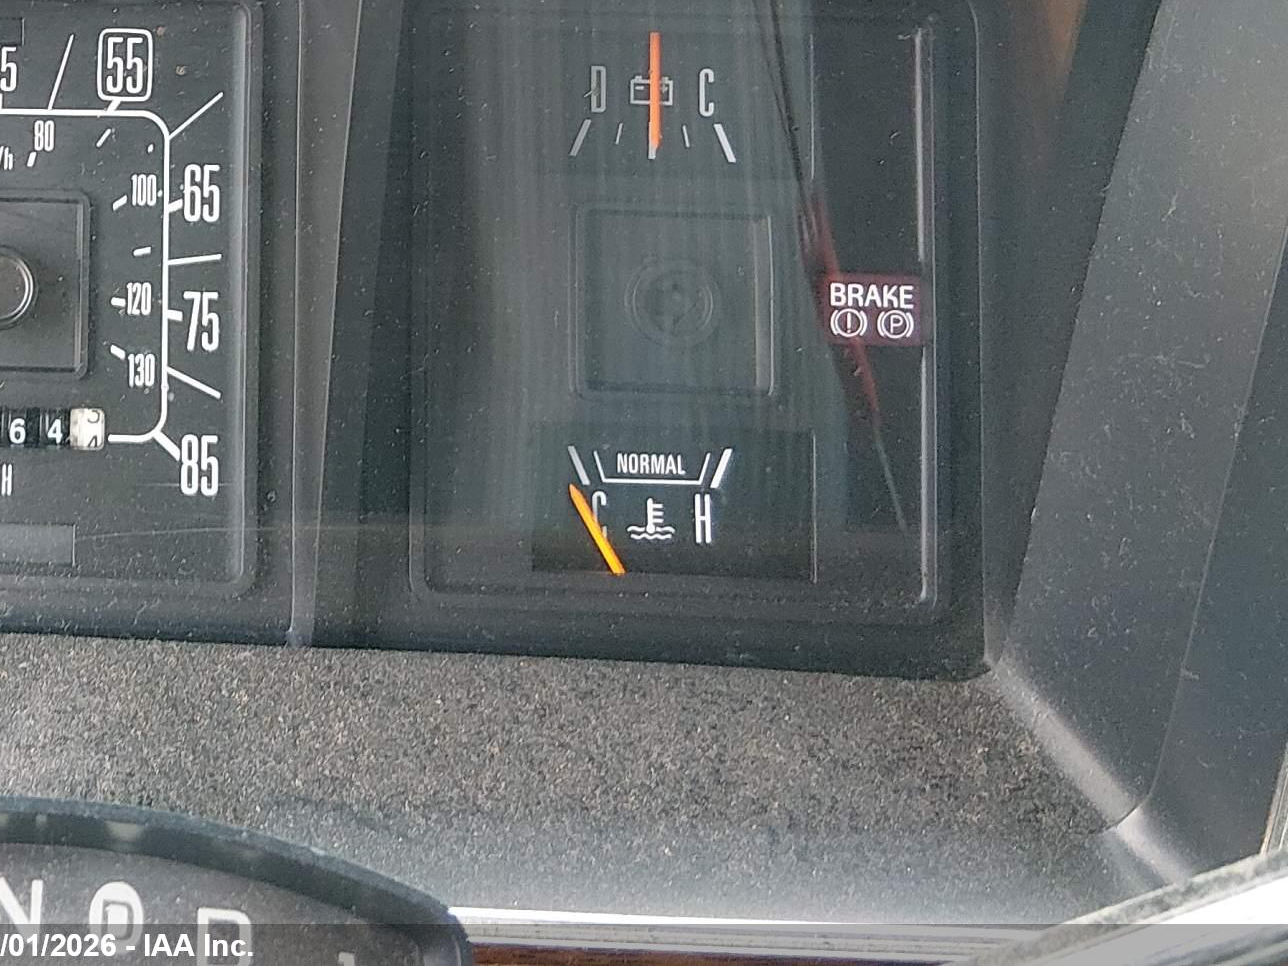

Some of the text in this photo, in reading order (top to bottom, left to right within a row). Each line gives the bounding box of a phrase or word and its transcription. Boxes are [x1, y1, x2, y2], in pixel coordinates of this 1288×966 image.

[106, 36, 144, 93] 55
[590, 65, 607, 113] D
[699, 68, 715, 117] C
[33, 121, 55, 151] 80
[131, 173, 157, 206] 100
[183, 164, 221, 222] 65
[126, 283, 153, 315] 120
[829, 282, 914, 309] BRAKE
[183, 291, 221, 352] 75
[127, 353, 156, 387] 130
[180, 435, 220, 497] 85
[616, 452, 686, 475] NORMAL
[694, 493, 712, 544] H
